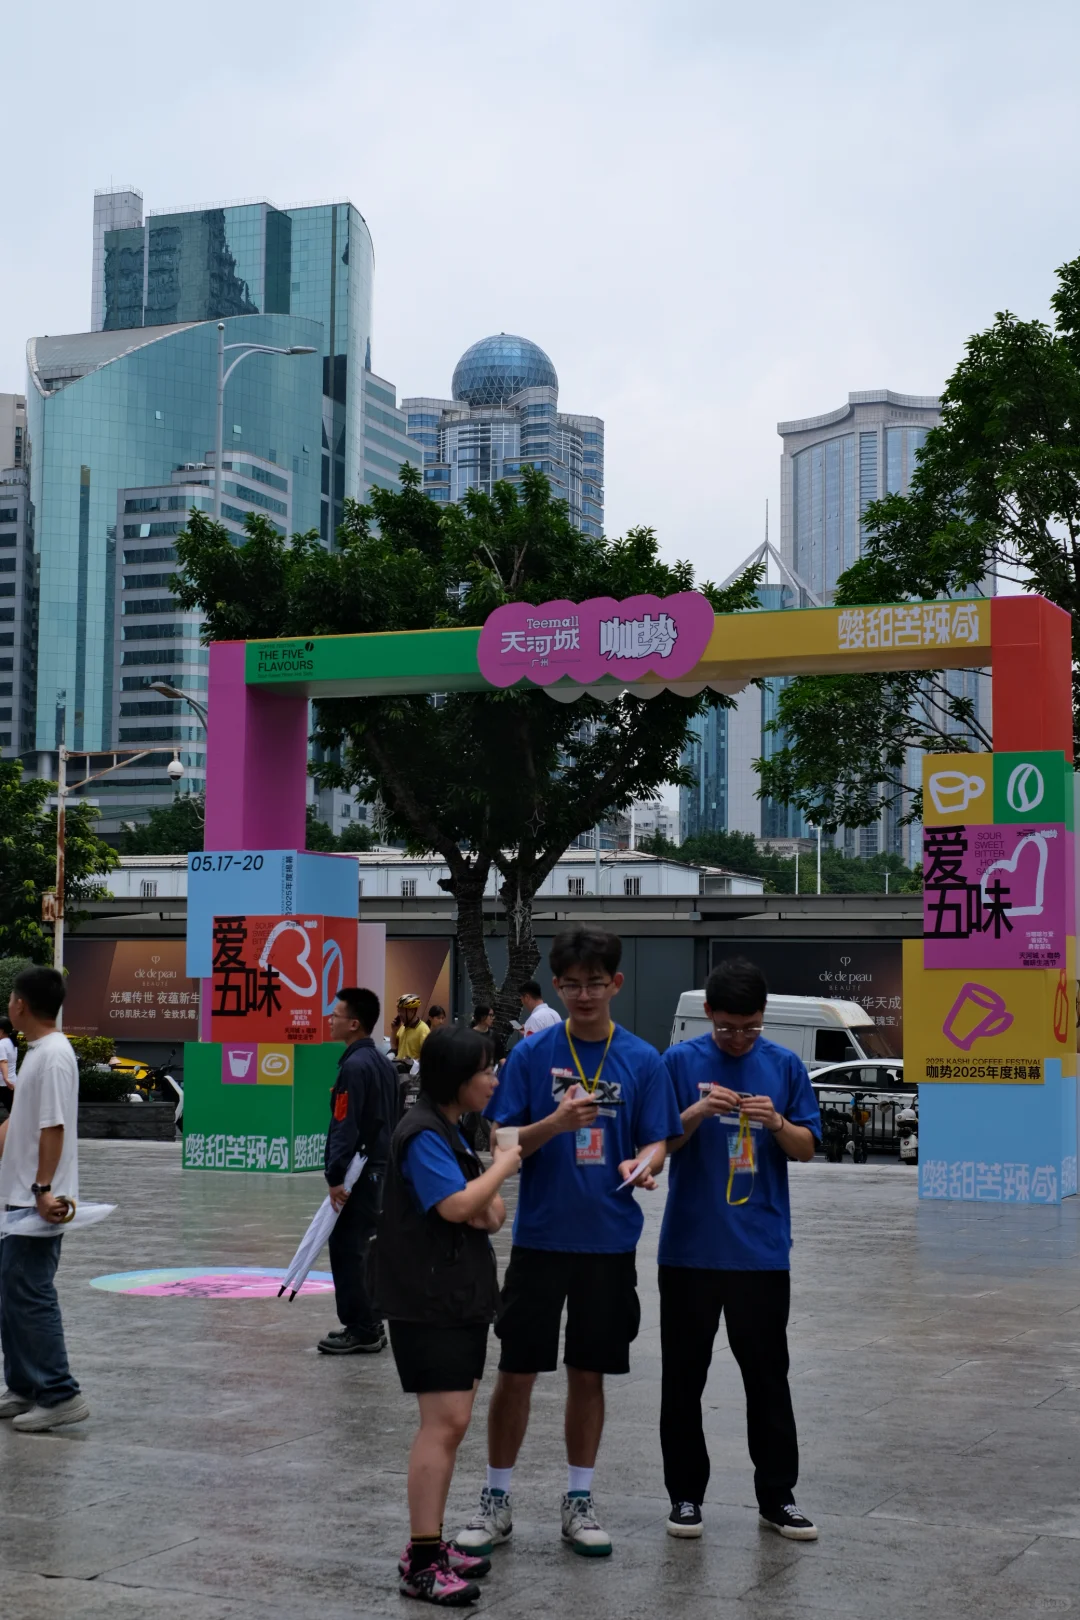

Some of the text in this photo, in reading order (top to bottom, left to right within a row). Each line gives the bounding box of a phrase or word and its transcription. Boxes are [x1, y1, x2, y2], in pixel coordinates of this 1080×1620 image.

[526, 616, 579, 629] Teemall
[838, 603, 979, 649] 酸甜苦辣咸
[500, 628, 580, 656] 天河城
[598, 612, 679, 661] 咖势
[258, 648, 304, 661] THE FIVE
[257, 659, 314, 672] FLAVOURS
[531, 658, 549, 667] 广州
[977, 831, 1002, 840] SOUR
[974, 840, 1004, 849] SWEET
[924, 825, 968, 885] 爱
[974, 849, 1005, 858] BITTER
[191, 855, 264, 872] 05.17-20
[980, 858, 999, 867] HOT
[976, 867, 1004, 876] SALTY
[924, 879, 1013, 939] 五味
[212, 916, 247, 967] 爱
[834, 970, 847, 982] de
[848, 972, 872, 984] peau
[211, 963, 282, 1017] 五味
[925, 1057, 945, 1065] 2025
[946, 1057, 970, 1065] KASHI
[925, 1065, 1041, 1080] 咖势2025年度揭幕
[185, 1134, 289, 1169] 酸甜苦辣咸
[922, 1160, 1058, 1202] 酸甜苦辣咸
